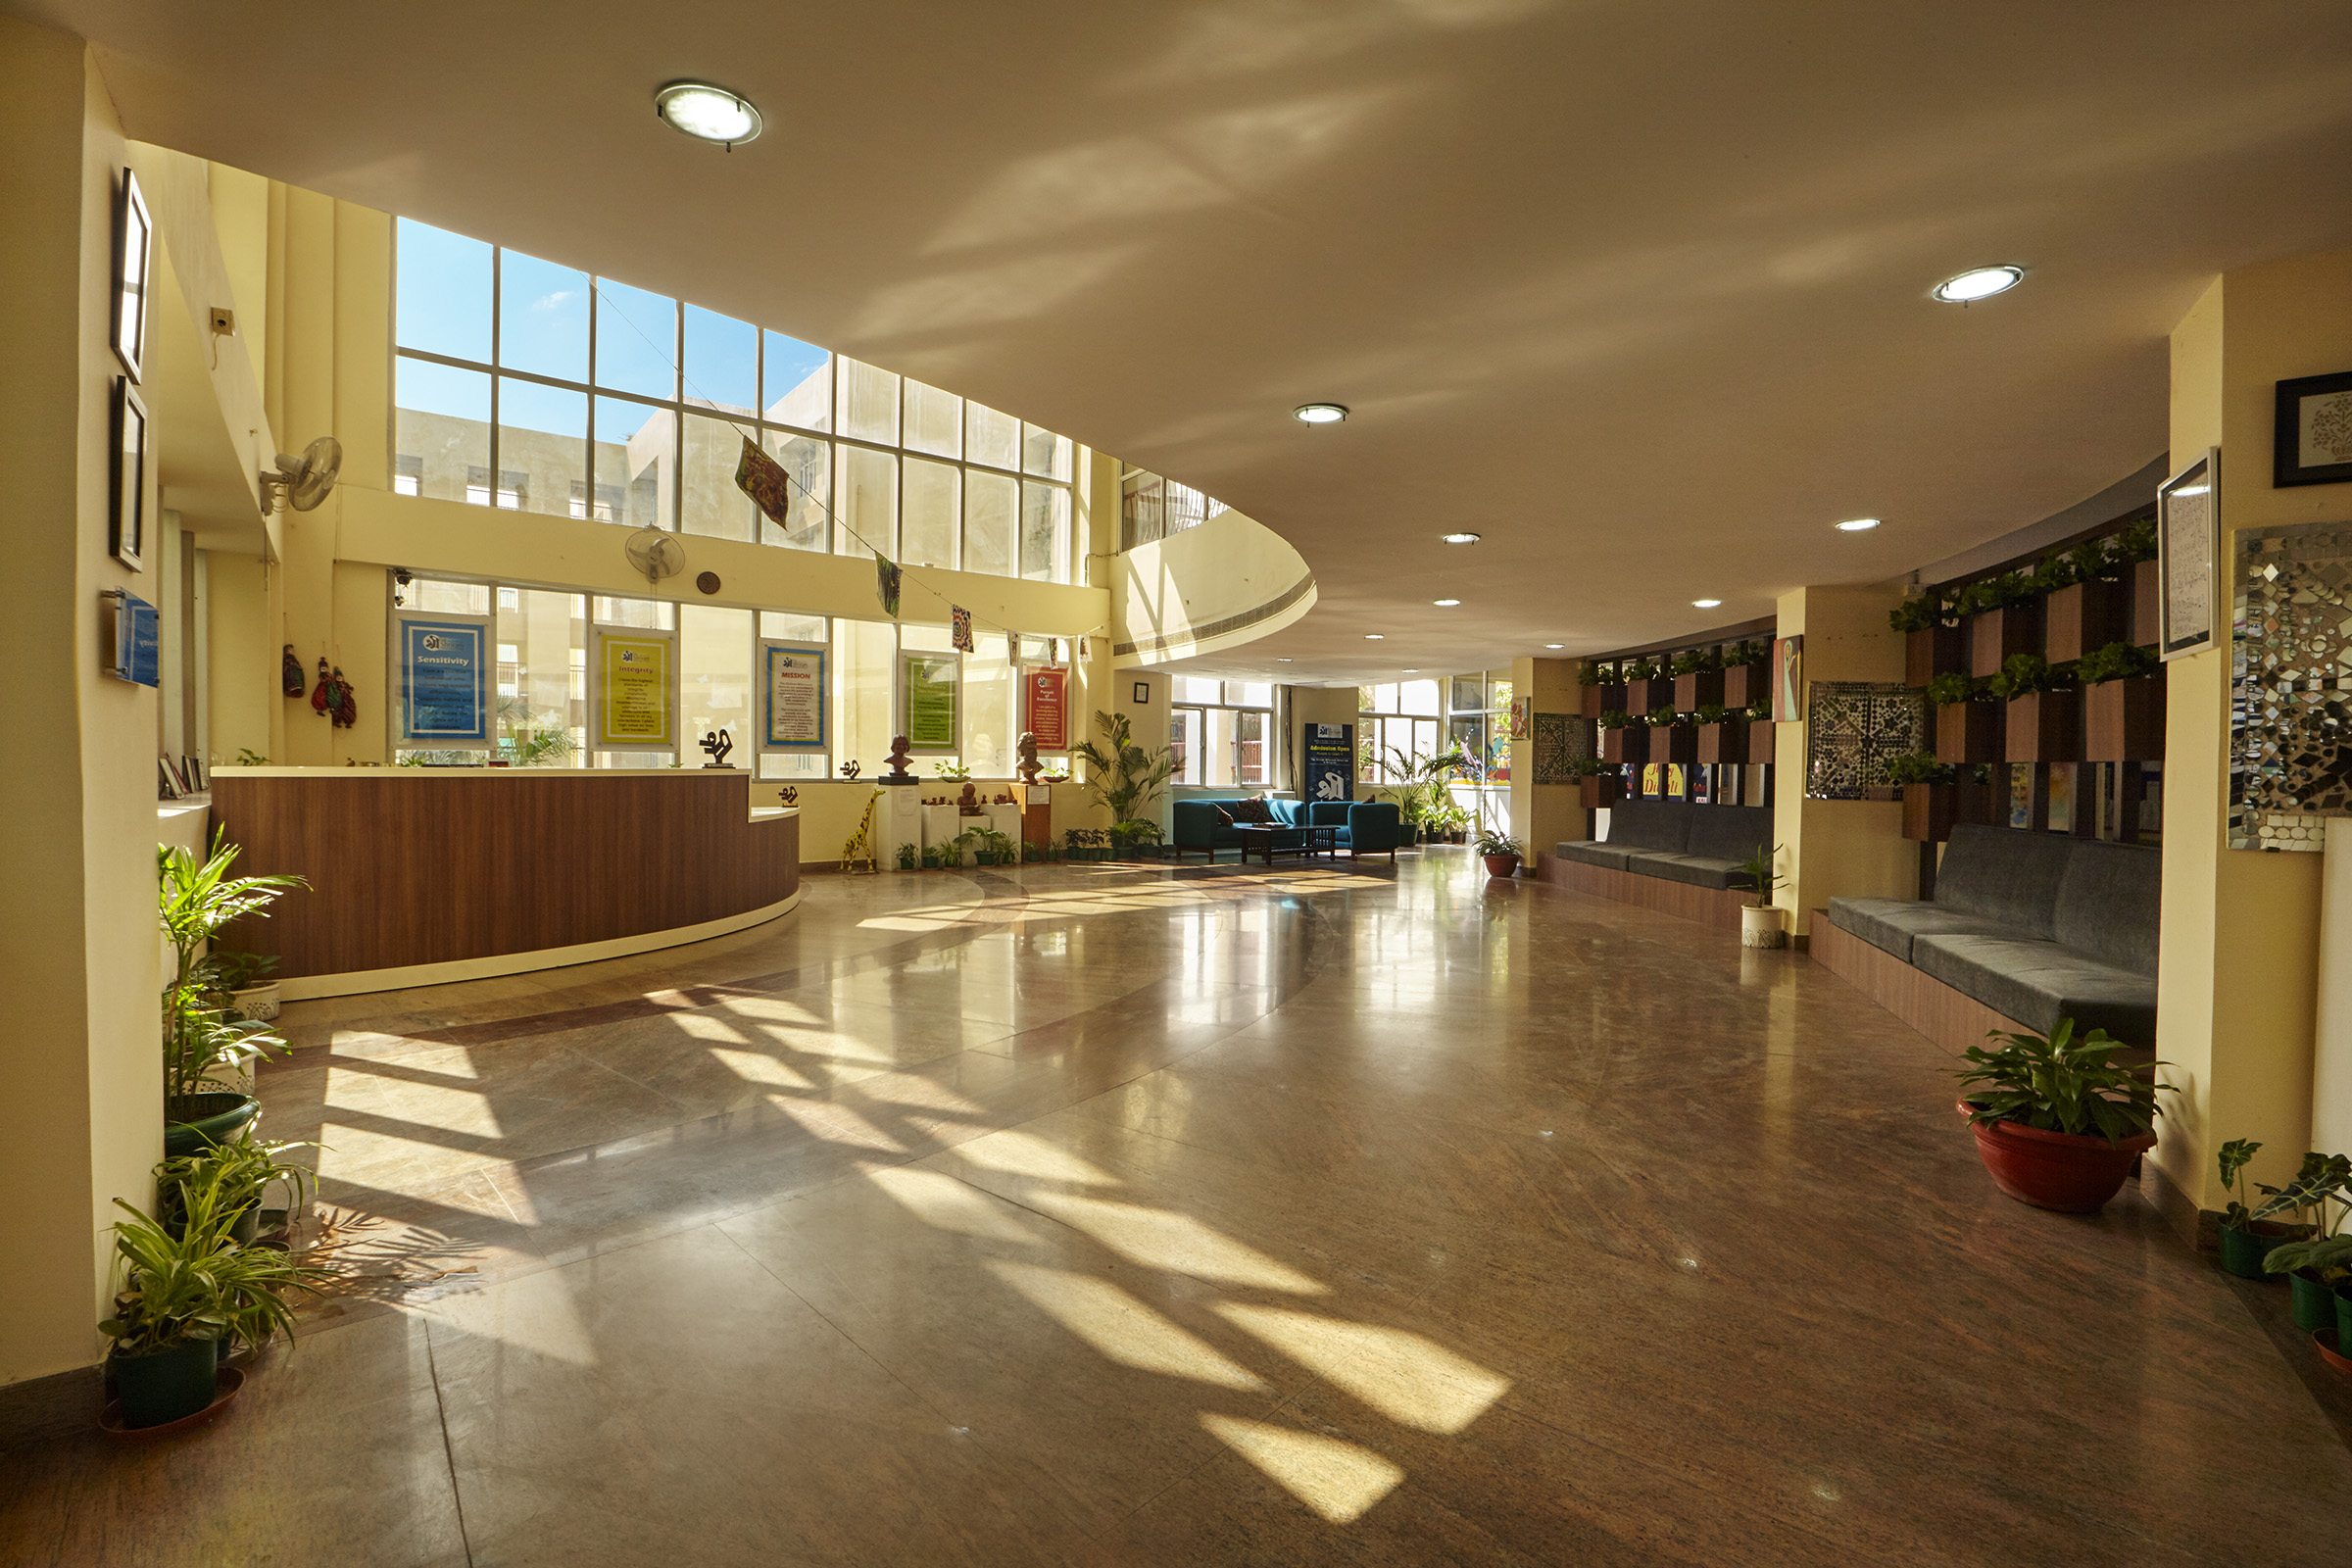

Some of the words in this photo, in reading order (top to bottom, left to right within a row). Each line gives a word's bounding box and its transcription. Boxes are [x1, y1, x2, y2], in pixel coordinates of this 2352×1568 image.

[417, 656, 469, 666] Sensitivity
[618, 665, 654, 675] Integrity
[1644, 778, 1679, 793] Dili
